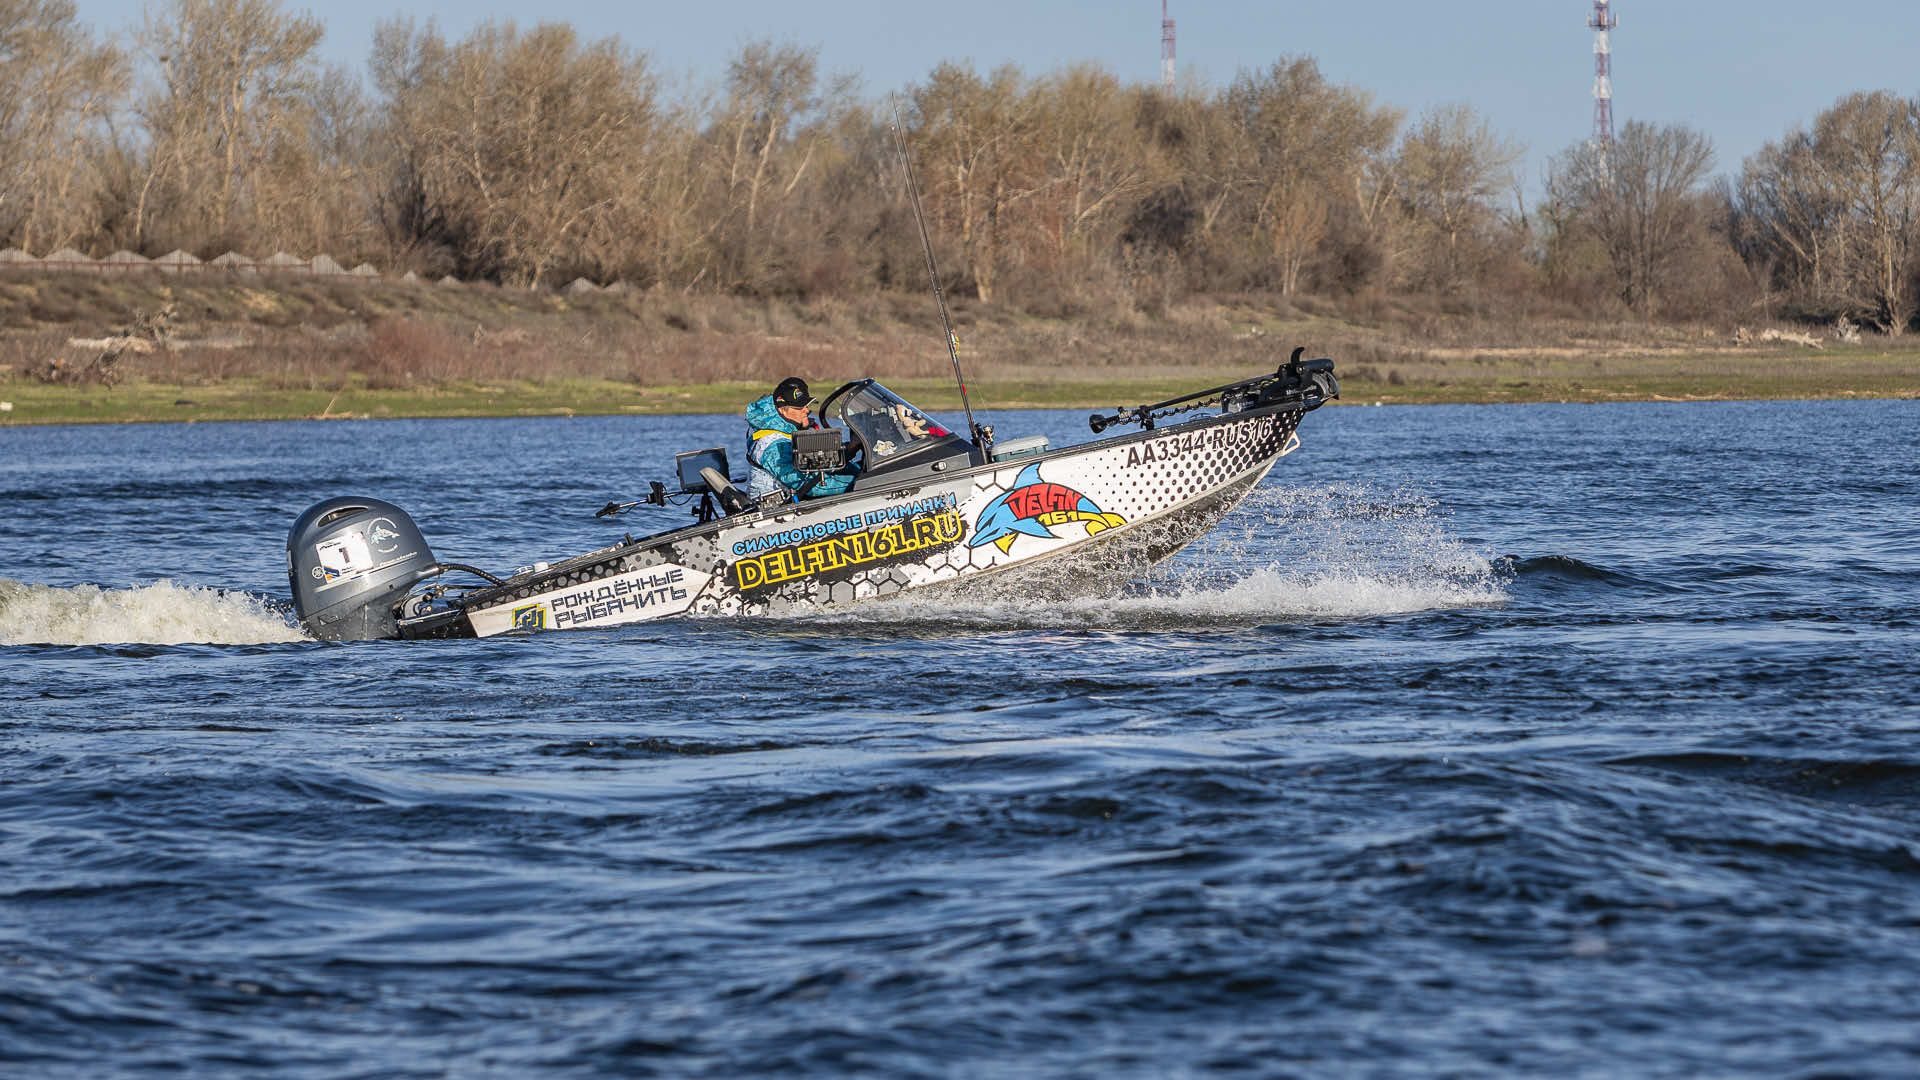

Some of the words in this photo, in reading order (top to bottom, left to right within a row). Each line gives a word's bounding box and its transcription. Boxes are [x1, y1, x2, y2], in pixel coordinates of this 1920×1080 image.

[733, 515, 862, 556] СИЛИКОНОВЫЕ
[865, 491, 957, 526] ПРИМАНКИ
[1038, 510, 1079, 526] 161
[735, 511, 964, 590] DELFIN161.RU
[550, 568, 684, 611] РОЖДЁННЫЕ
[554, 586, 688, 629] РЫБАЧИТЬ
